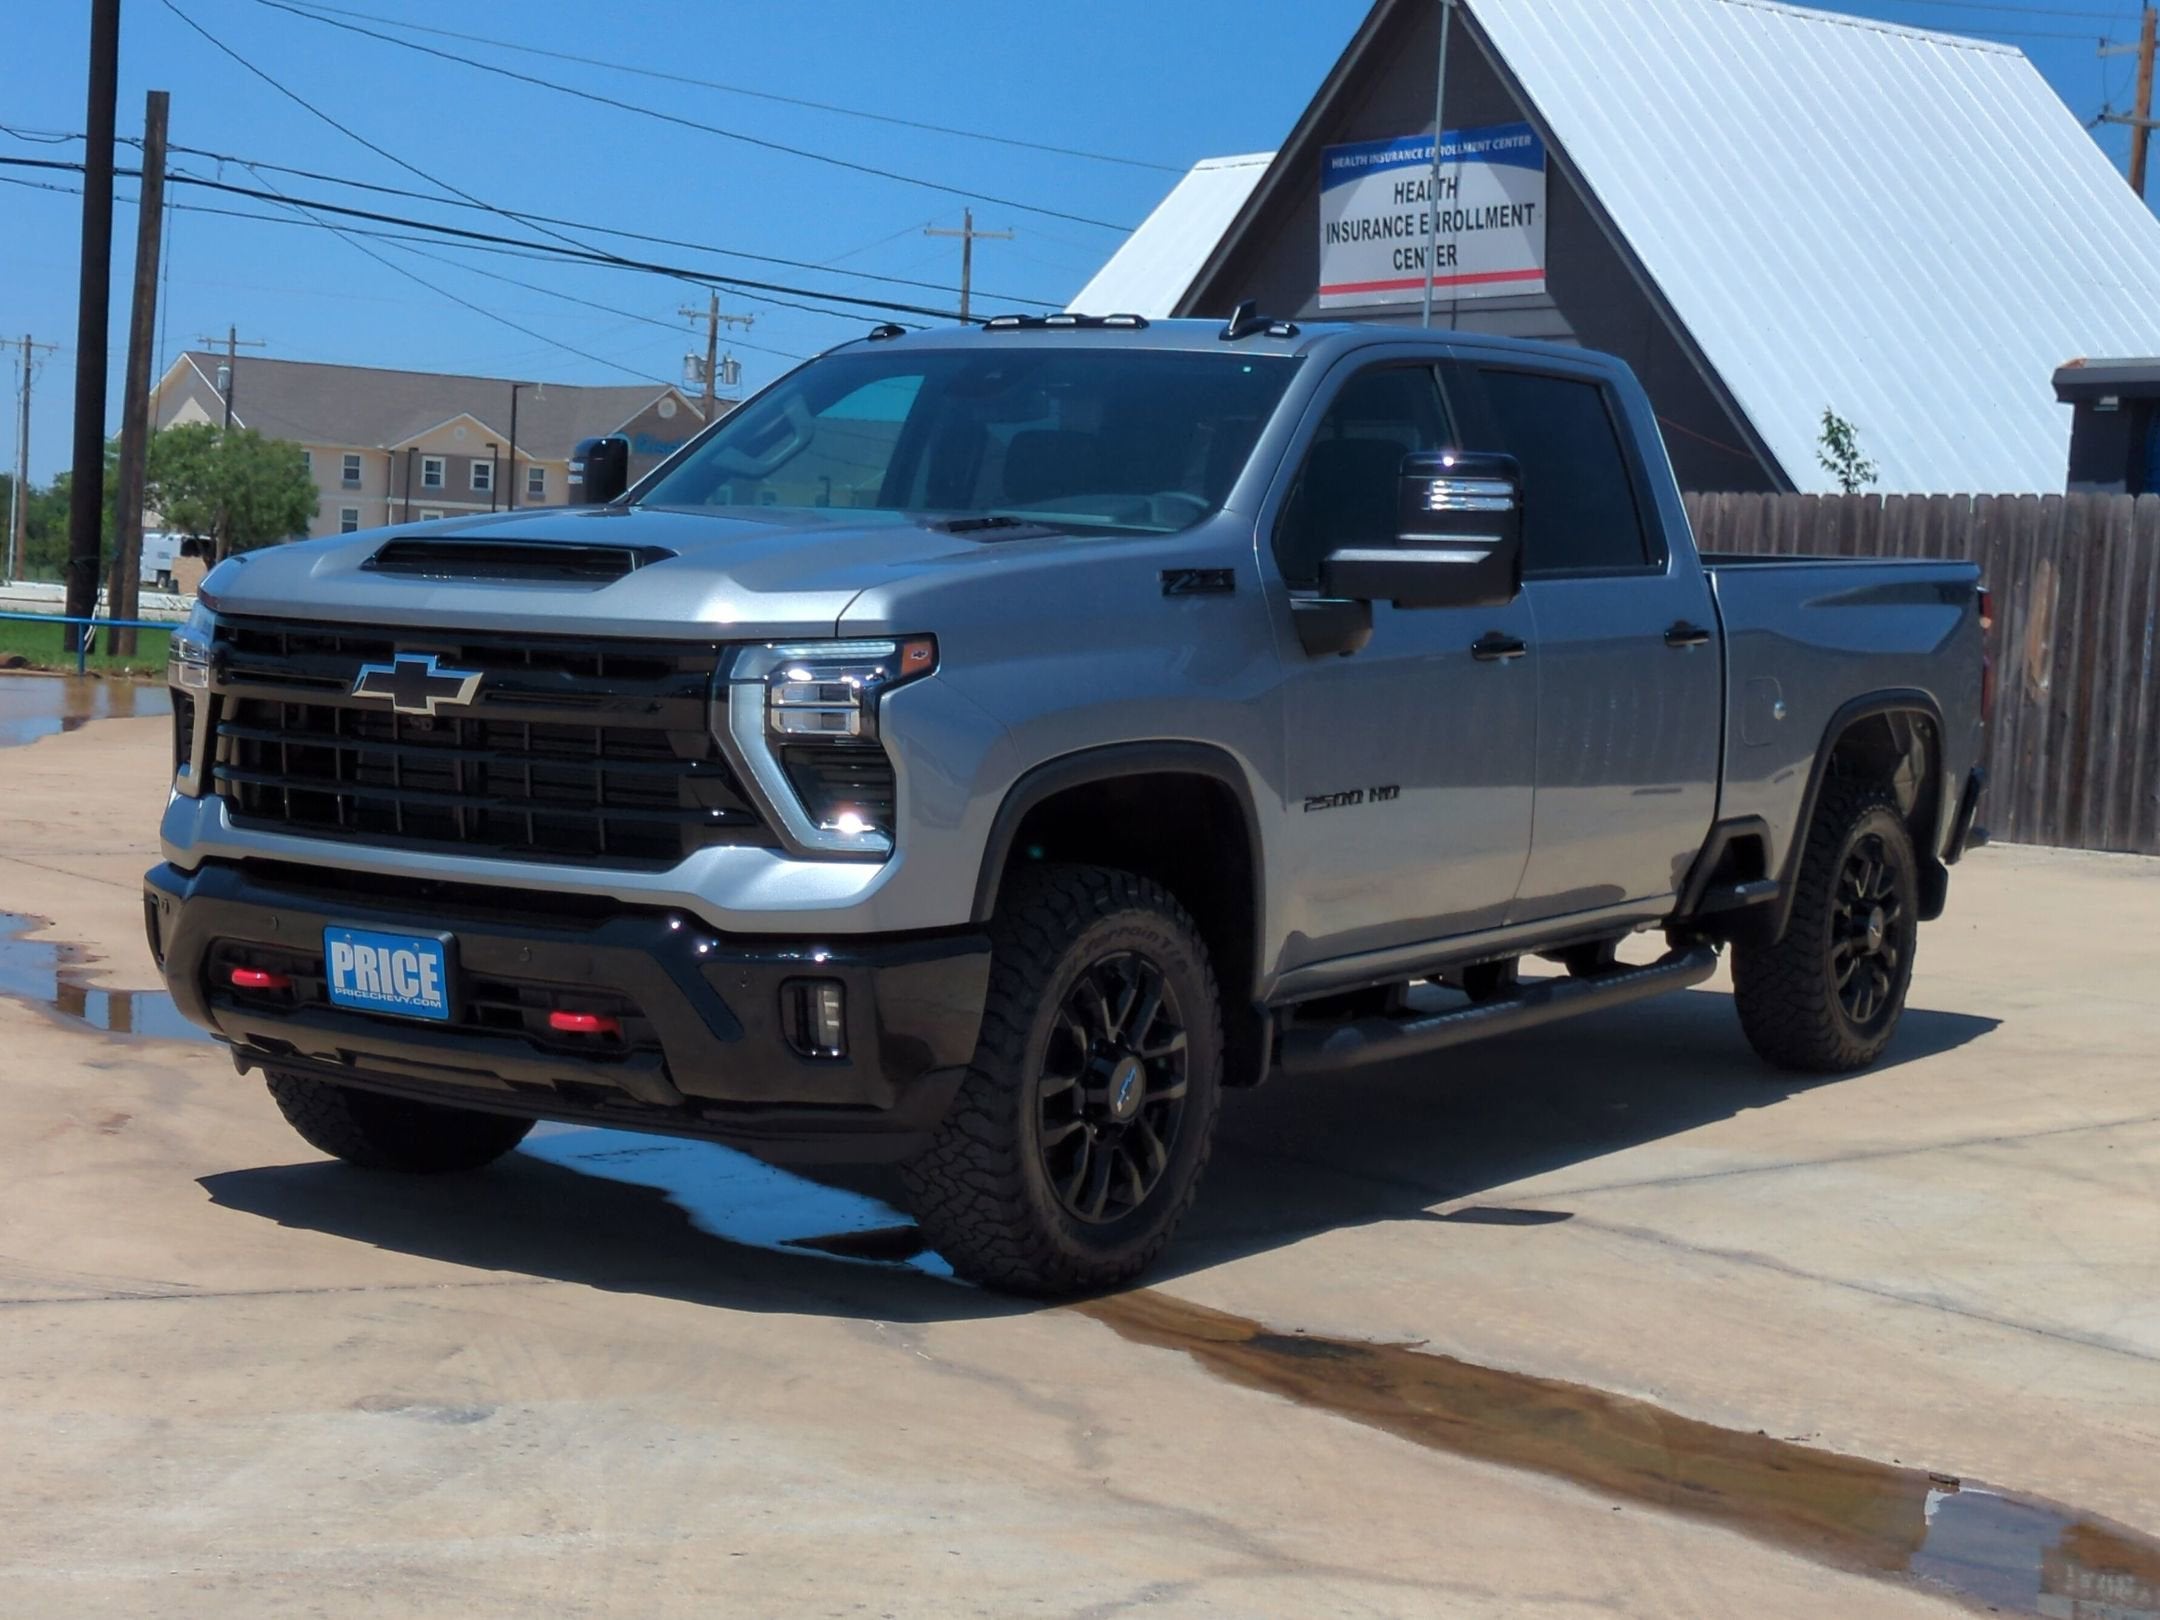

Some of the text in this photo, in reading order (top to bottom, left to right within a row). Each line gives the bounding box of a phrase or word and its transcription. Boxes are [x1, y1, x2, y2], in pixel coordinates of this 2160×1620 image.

[1331, 156, 1368, 169] HEALTH
[1369, 148, 1423, 165] INSURANCE
[1492, 135, 1532, 150] CENTER
[1394, 176, 1458, 205] HEALTH
[1326, 214, 1414, 245] INSURANCE
[1393, 244, 1458, 271] CENER
[1304, 789, 1364, 813] 2500
[331, 941, 441, 1001] PRICE
[334, 986, 442, 1009] PRICECHEVY.COM
